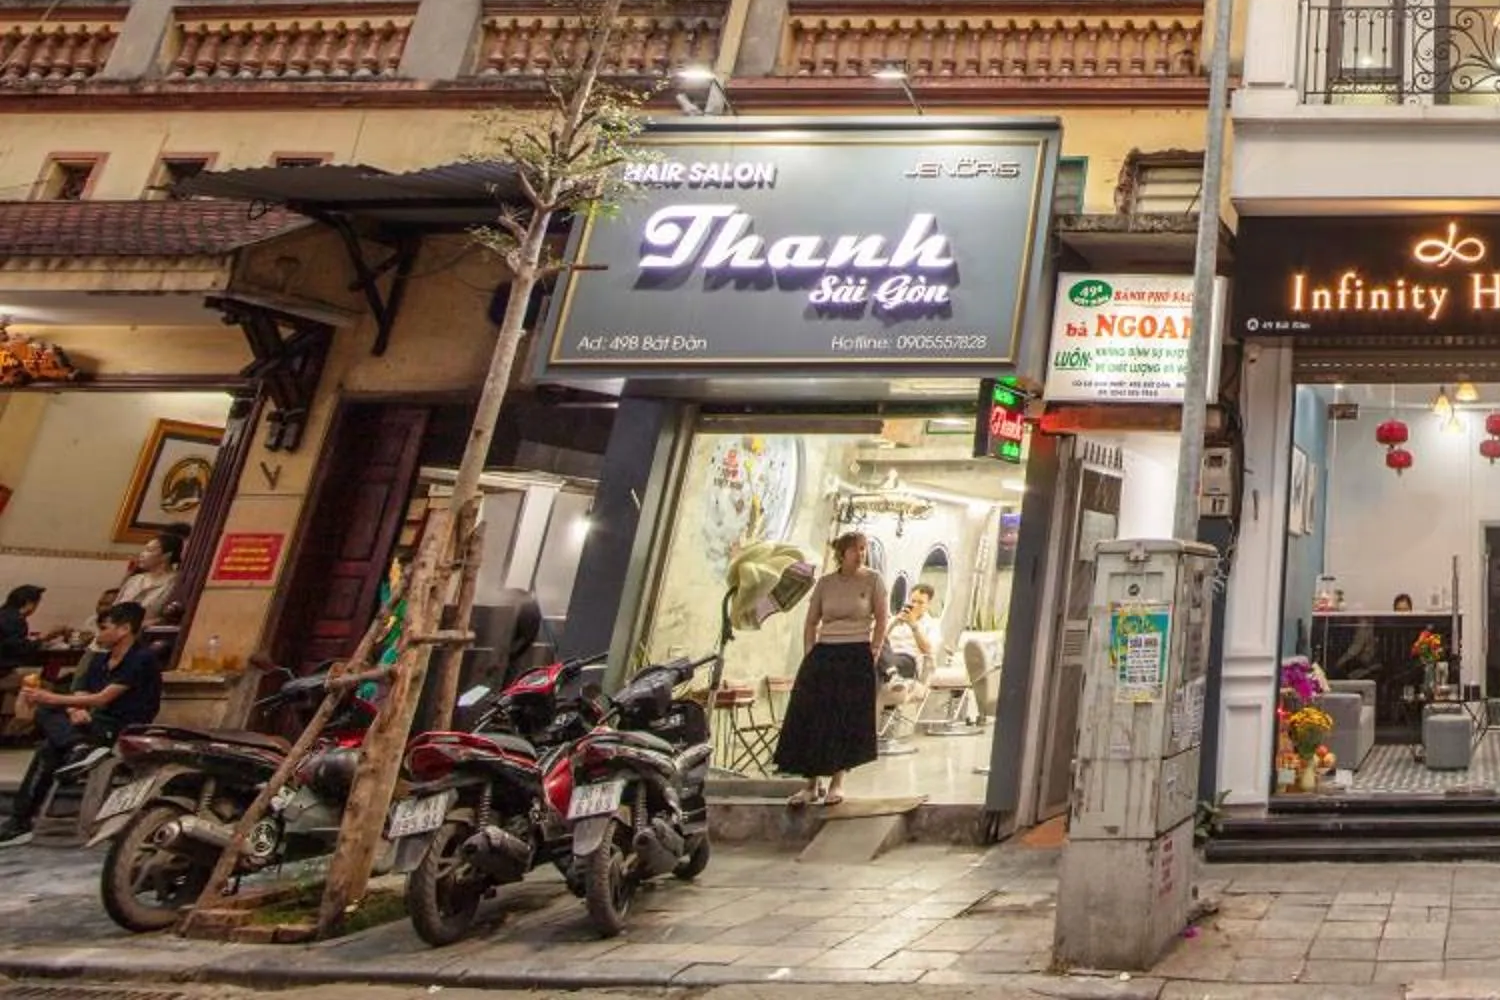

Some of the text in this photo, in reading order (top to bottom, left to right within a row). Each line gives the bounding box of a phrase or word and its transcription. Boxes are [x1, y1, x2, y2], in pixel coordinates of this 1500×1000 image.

[624, 161, 776, 182] HAIR SALON
[638, 203, 955, 270] Thanh
[1292, 272, 1449, 320] Infinity
